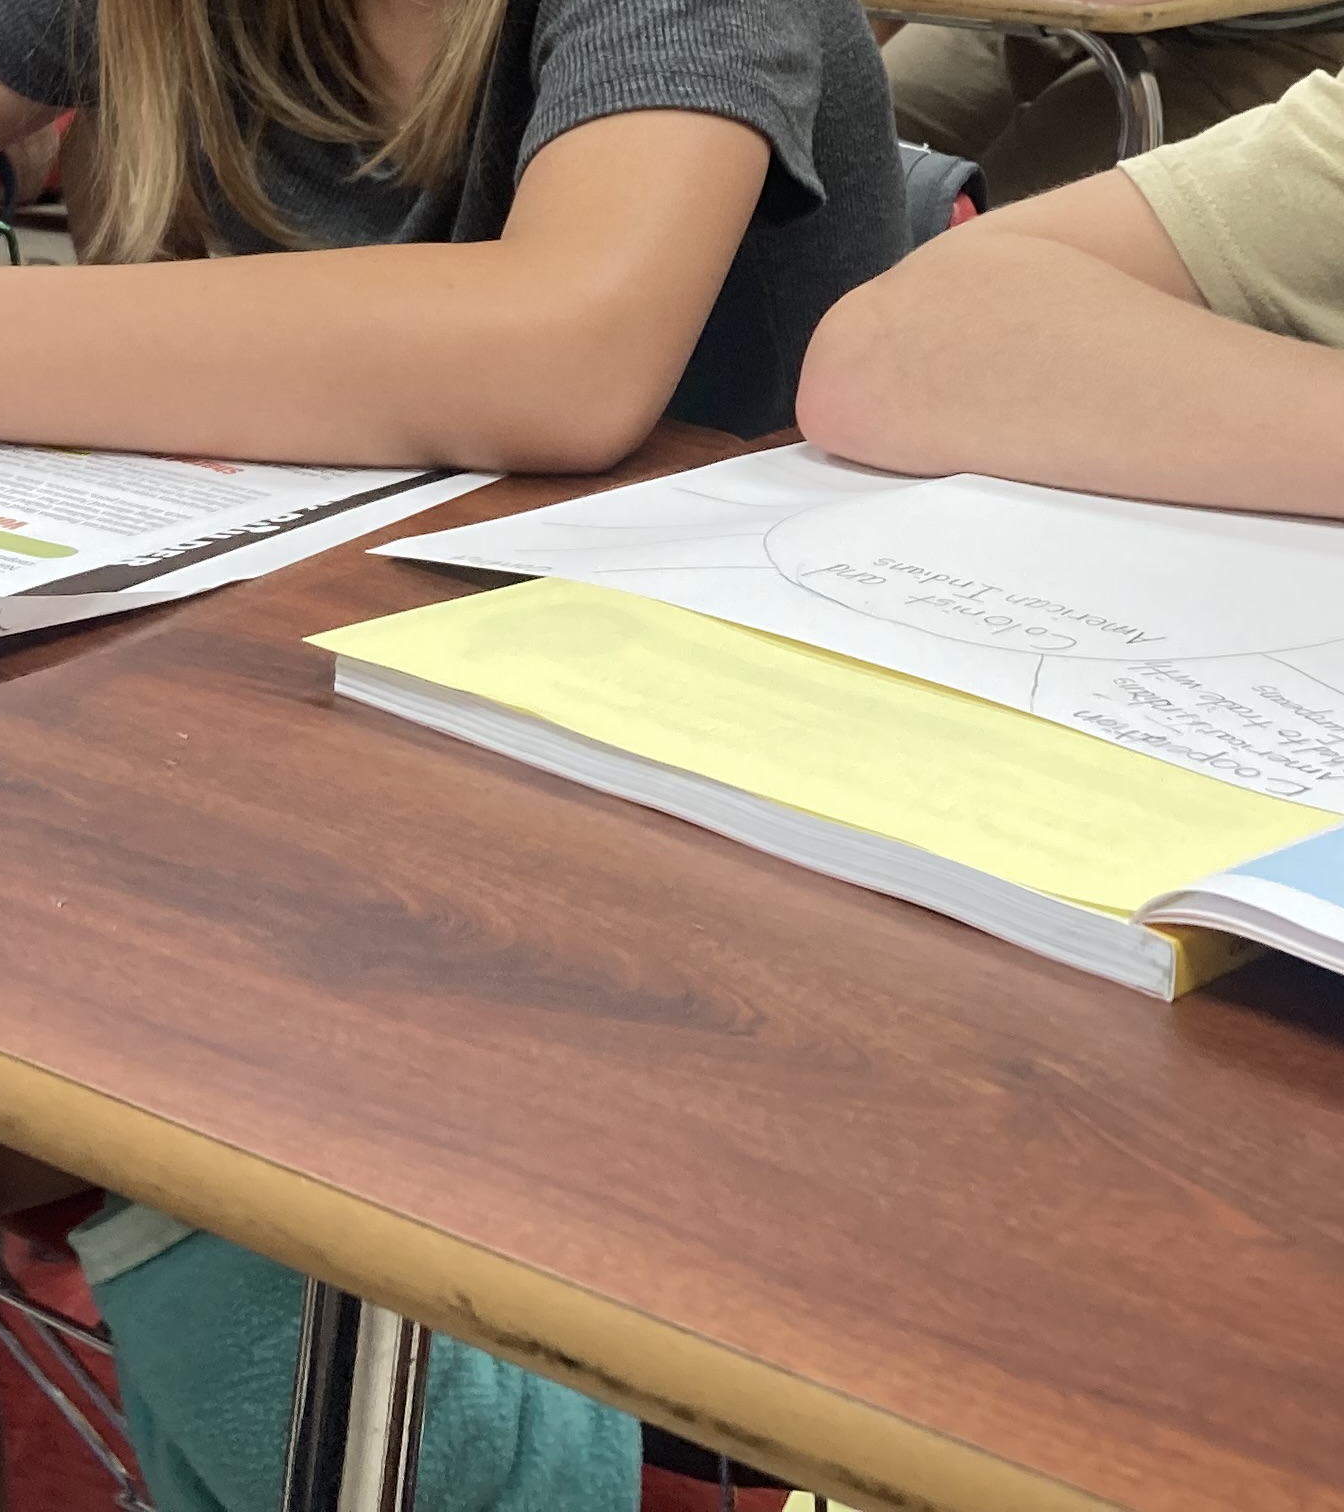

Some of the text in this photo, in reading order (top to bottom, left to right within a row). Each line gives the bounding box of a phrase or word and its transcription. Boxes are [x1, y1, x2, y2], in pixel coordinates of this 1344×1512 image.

[800, 563, 1078, 651] Colonist and
[872, 557, 1167, 645] American Indians
